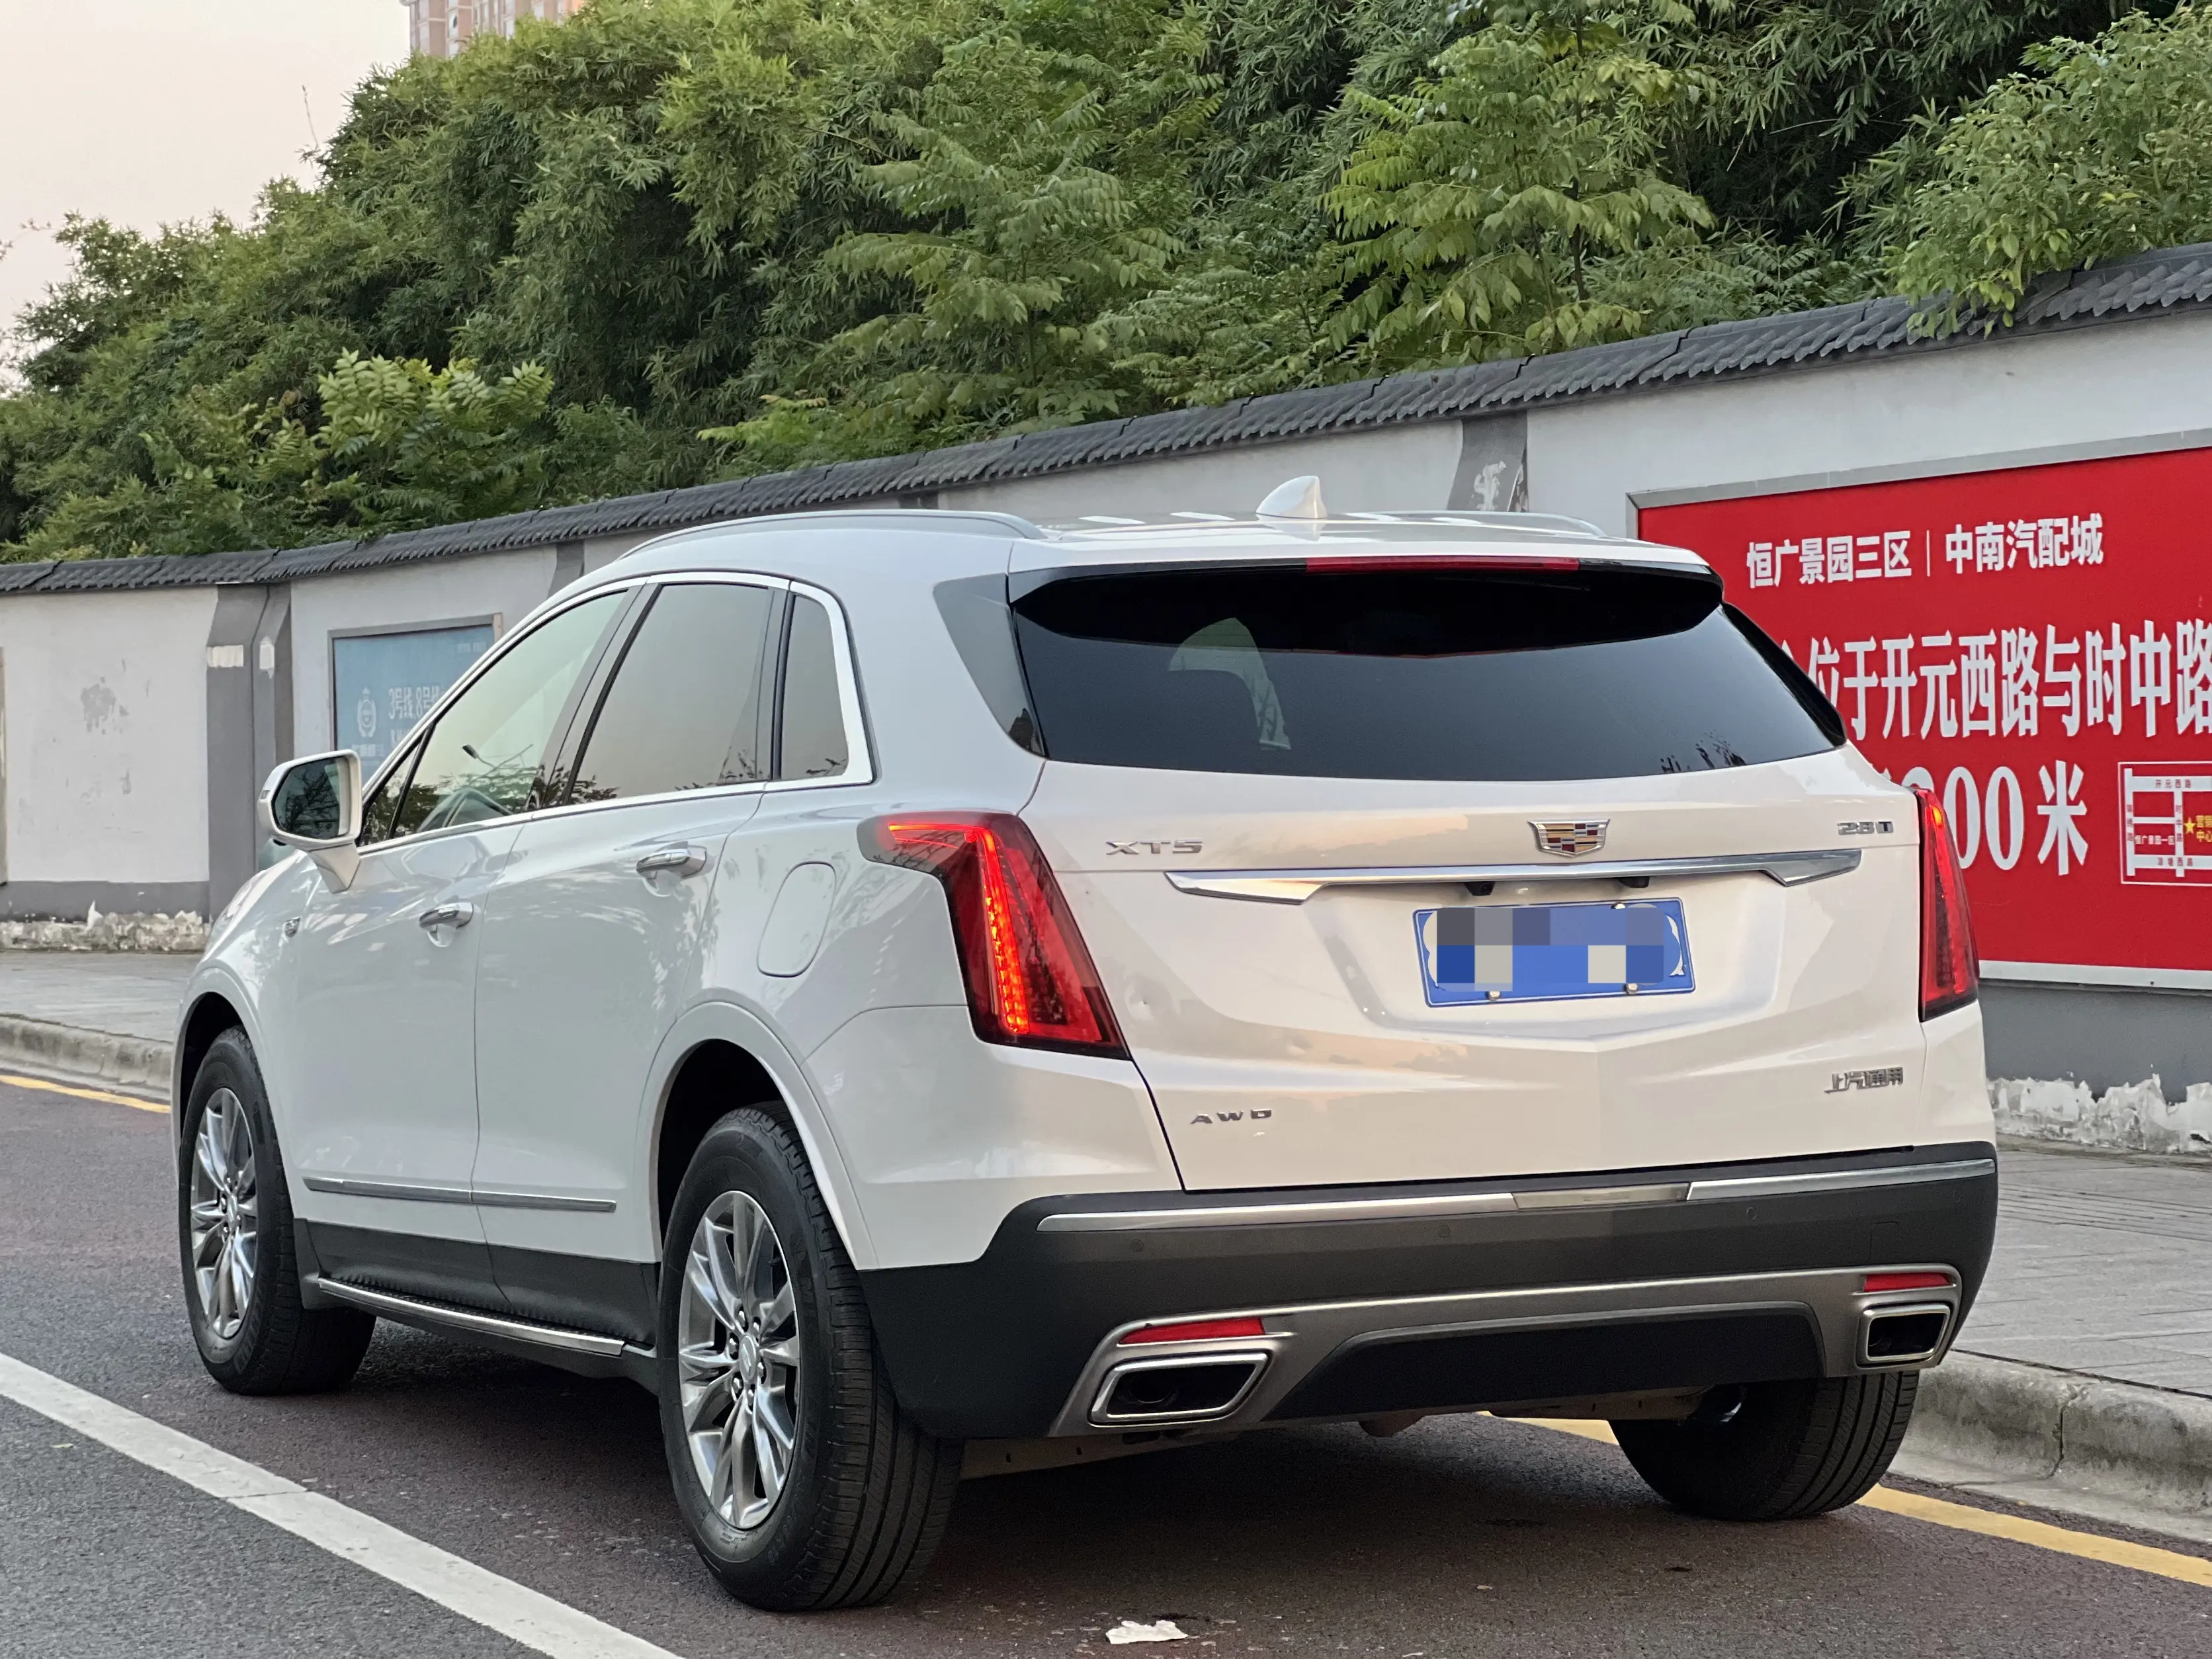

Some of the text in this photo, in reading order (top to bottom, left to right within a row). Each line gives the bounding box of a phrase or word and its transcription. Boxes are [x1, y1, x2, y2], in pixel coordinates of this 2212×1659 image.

[1746, 513, 2104, 589] 恒广景园三区 中南汽配城
[1782, 618, 2212, 741] 位于开元西路与时中路
[1836, 820, 1894, 835] 28T
[1105, 840, 1203, 855] XT5
[1190, 1108, 1272, 1125] AWD
